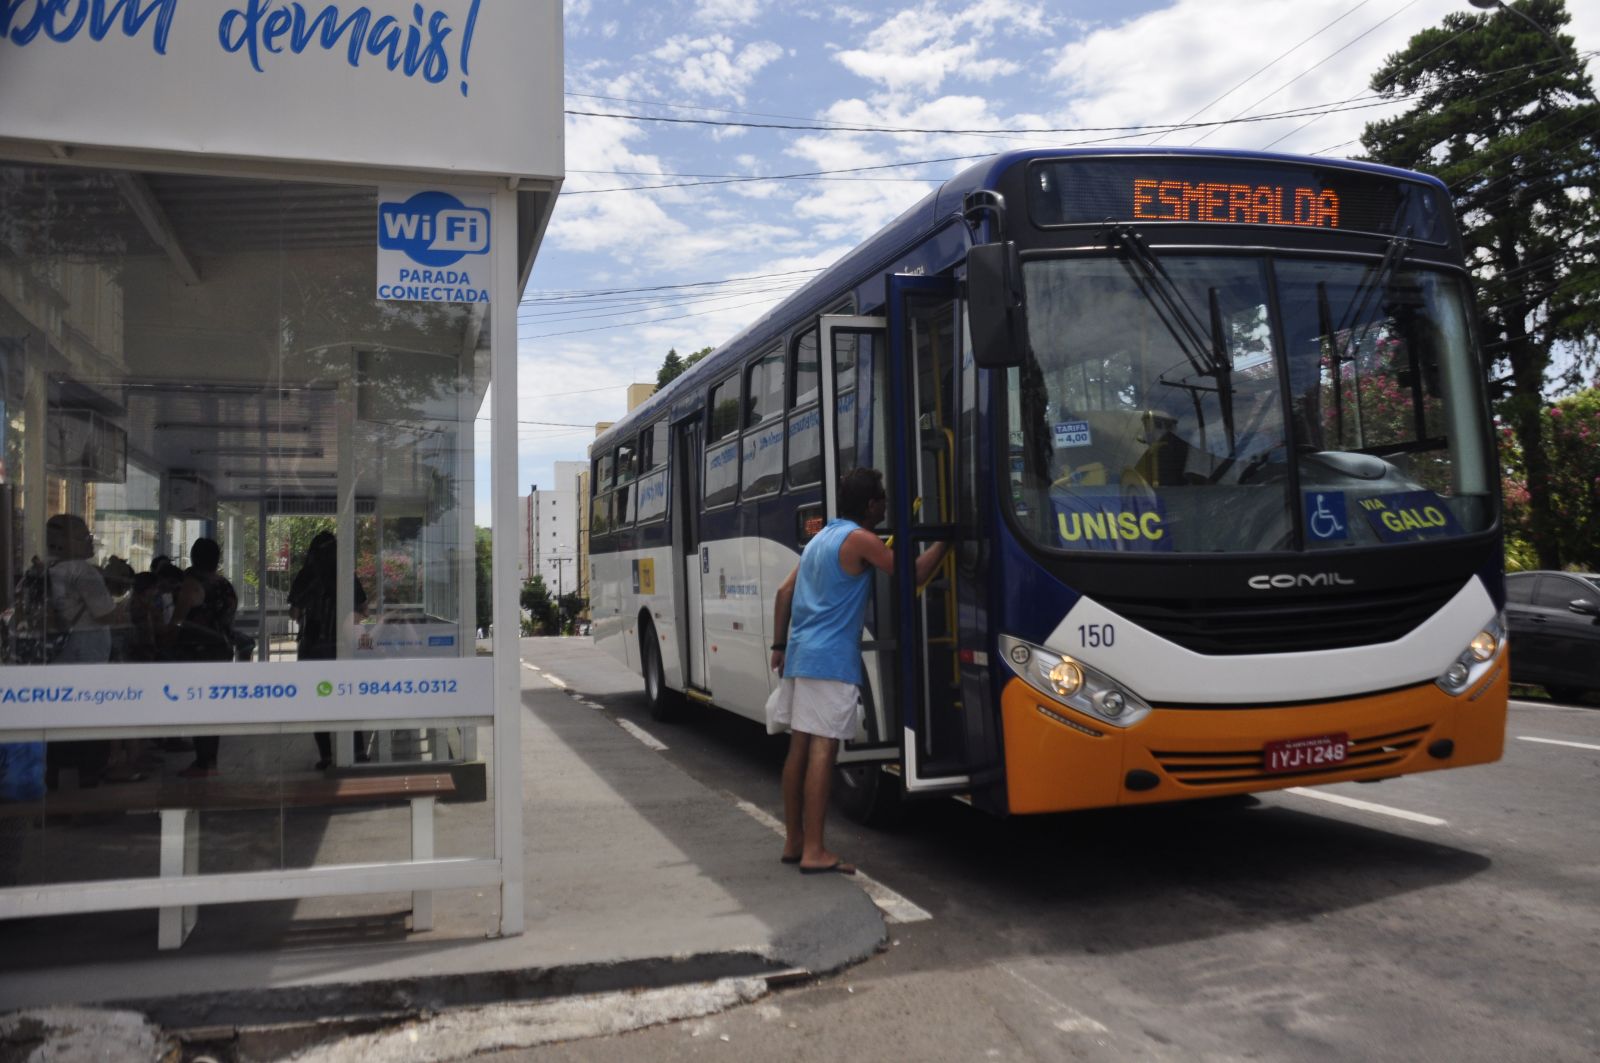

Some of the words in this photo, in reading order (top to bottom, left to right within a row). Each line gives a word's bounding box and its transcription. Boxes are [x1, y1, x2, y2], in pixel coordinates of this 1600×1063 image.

[218, 0, 481, 97] demais!
[1134, 179, 1340, 227] ESMERALDA
[399, 269, 470, 285] PARADA
[378, 285, 489, 302] CONECTADA
[1055, 424, 1087, 433] TARIFA
[1066, 433, 1088, 443] 4,00
[1359, 498, 1386, 511] VIA
[1057, 512, 1164, 541] UNISC
[1381, 506, 1446, 532] GALO
[1248, 573, 1354, 589] COMIL
[1078, 624, 1115, 648] 150
[0, 686, 144, 705] ACRUZ.rs.gov.br
[186, 687, 203, 700] 51
[208, 684, 297, 700] 3713.8100
[337, 683, 353, 696] 51
[358, 680, 457, 695] 98443.0312
